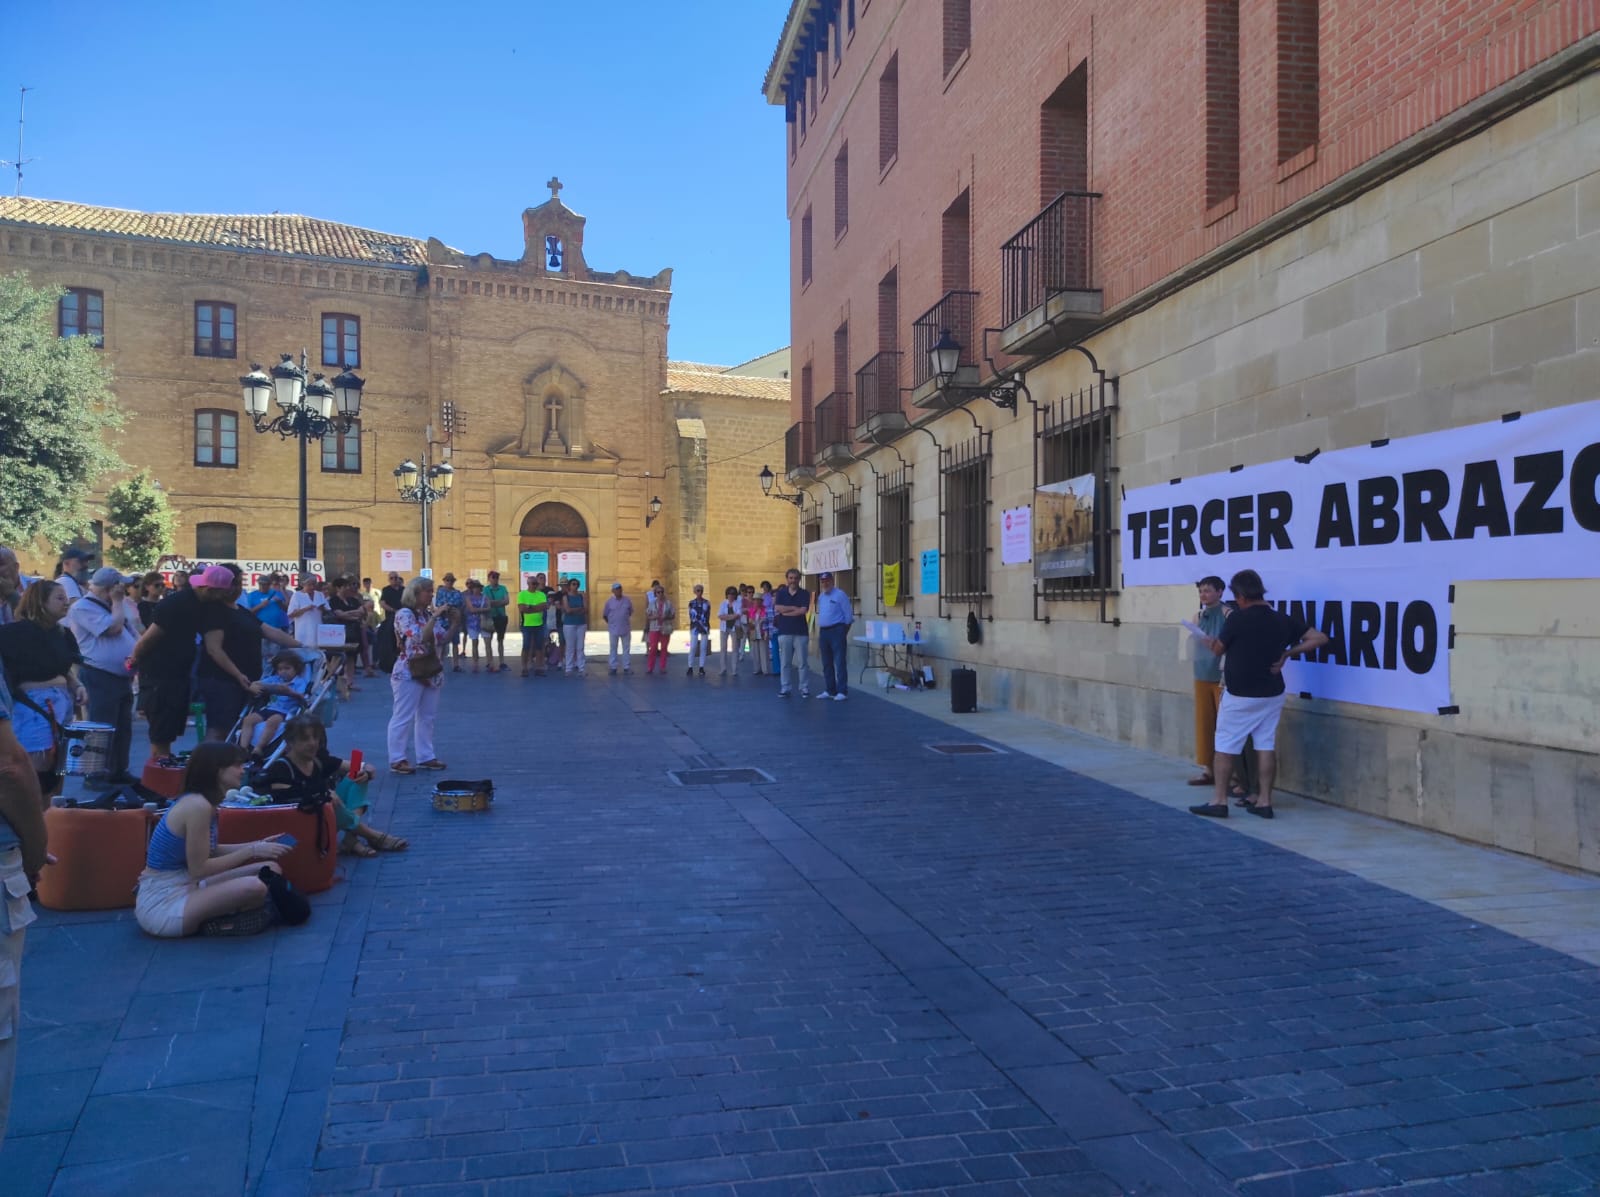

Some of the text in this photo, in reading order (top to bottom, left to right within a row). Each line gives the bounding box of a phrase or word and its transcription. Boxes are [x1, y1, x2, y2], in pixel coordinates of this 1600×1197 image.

[1127, 490, 1294, 559] TERCER
[246, 562, 323, 572] SEMINAIO
[1200, 599, 1438, 675] NARIO
